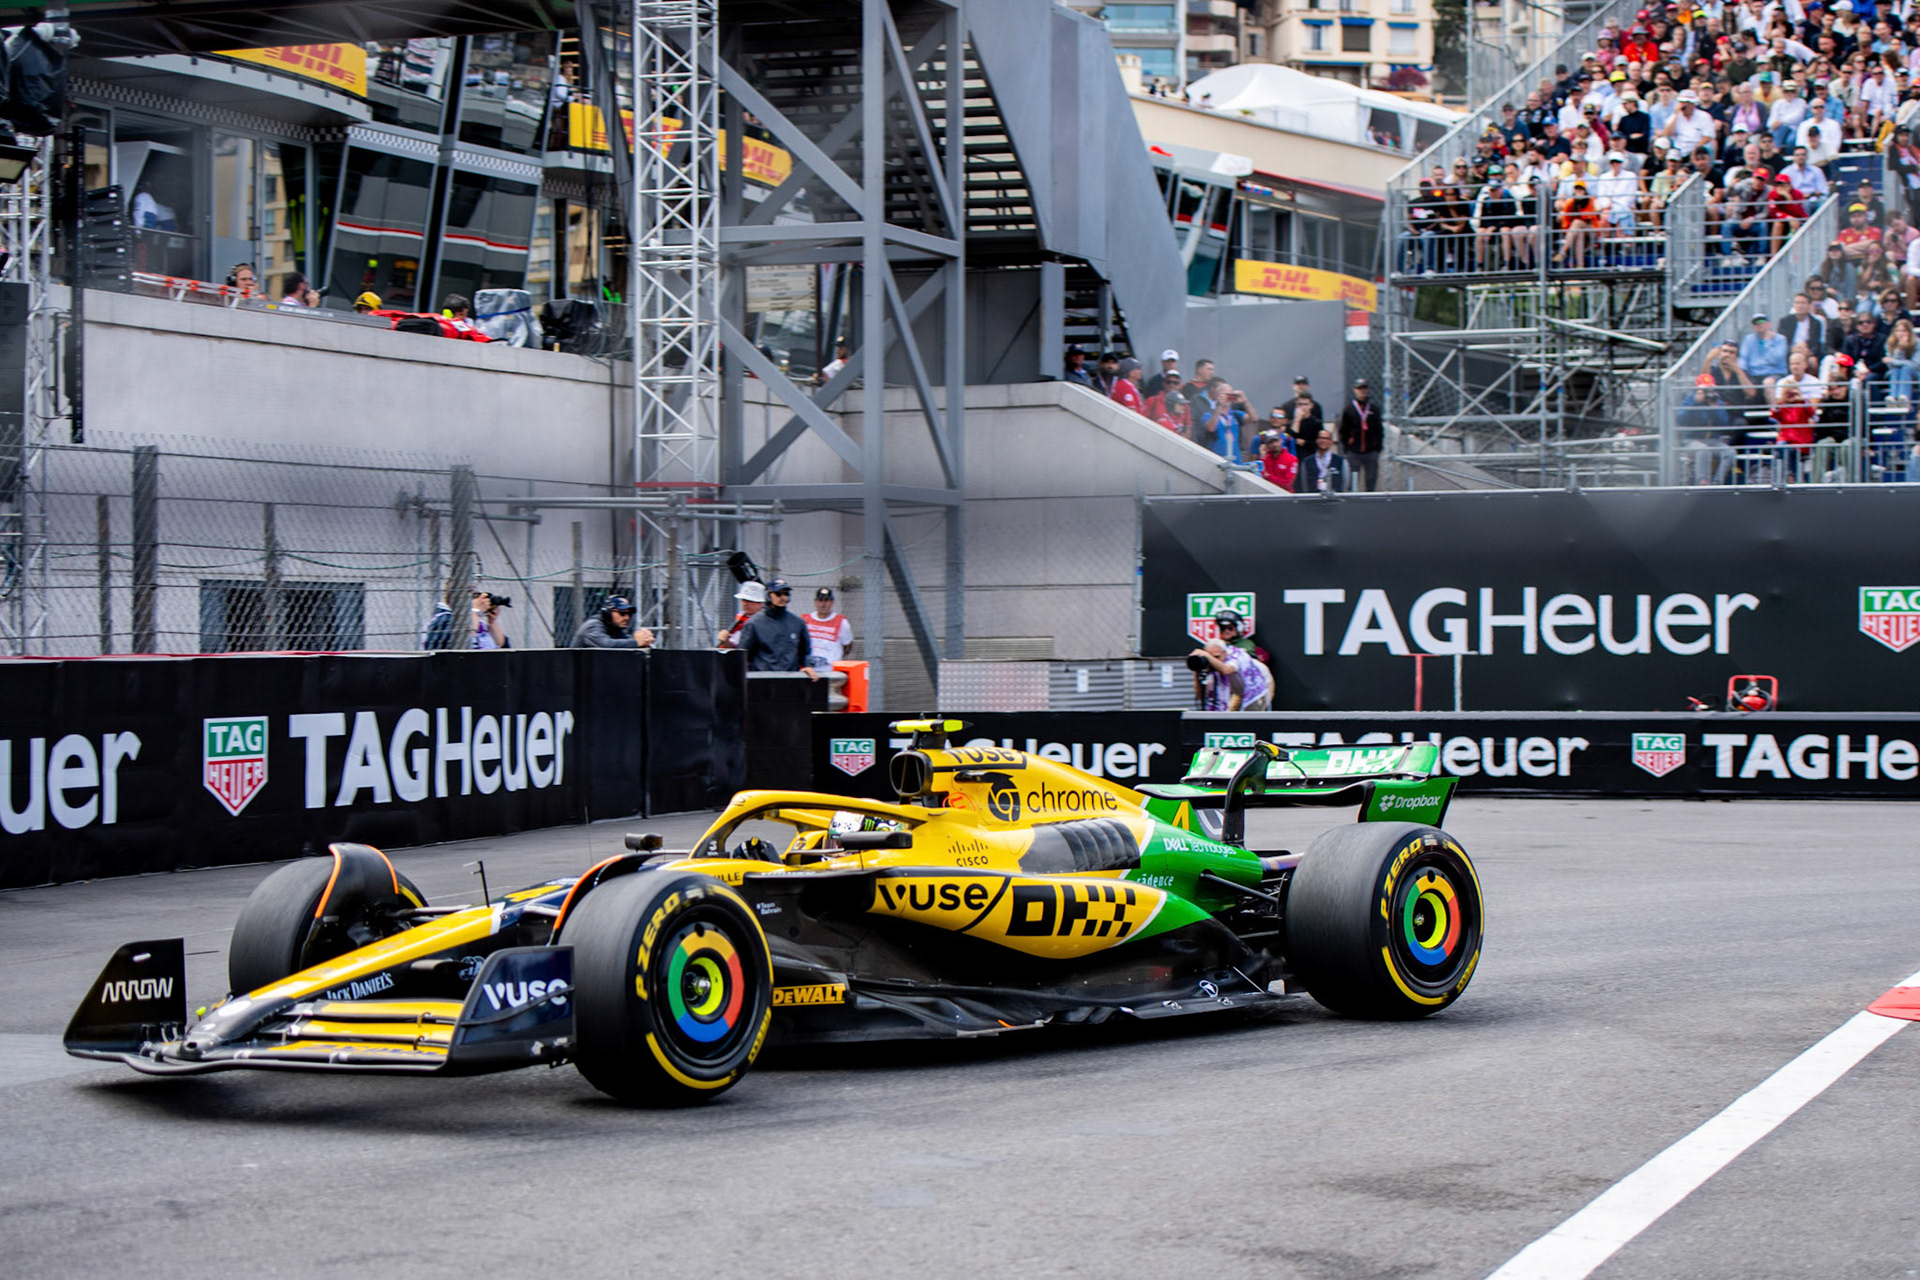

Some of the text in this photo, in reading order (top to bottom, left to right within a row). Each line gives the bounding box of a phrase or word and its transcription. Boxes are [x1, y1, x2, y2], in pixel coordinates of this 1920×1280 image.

[1262, 267, 1312, 293] DHL
[1193, 597, 1249, 616] TAG
[1863, 615, 1920, 646] HEUE
[210, 724, 263, 753] TAG
[836, 741, 871, 752] TAG
[1210, 736, 1250, 748] TAG
[1638, 737, 1680, 750] TAG
[0, 731, 142, 834] uer
[208, 761, 264, 806] HEUER
[1027, 782, 1117, 813] chrome
[1394, 794, 1441, 811] Dropbox
[1162, 838, 1237, 857] DELL Technologies
[1381, 837, 1423, 921] P ZERO
[636, 892, 680, 1000] P ZERO
[101, 977, 174, 1004] ARROW
[326, 971, 395, 1000] JACK DANIEL'S
